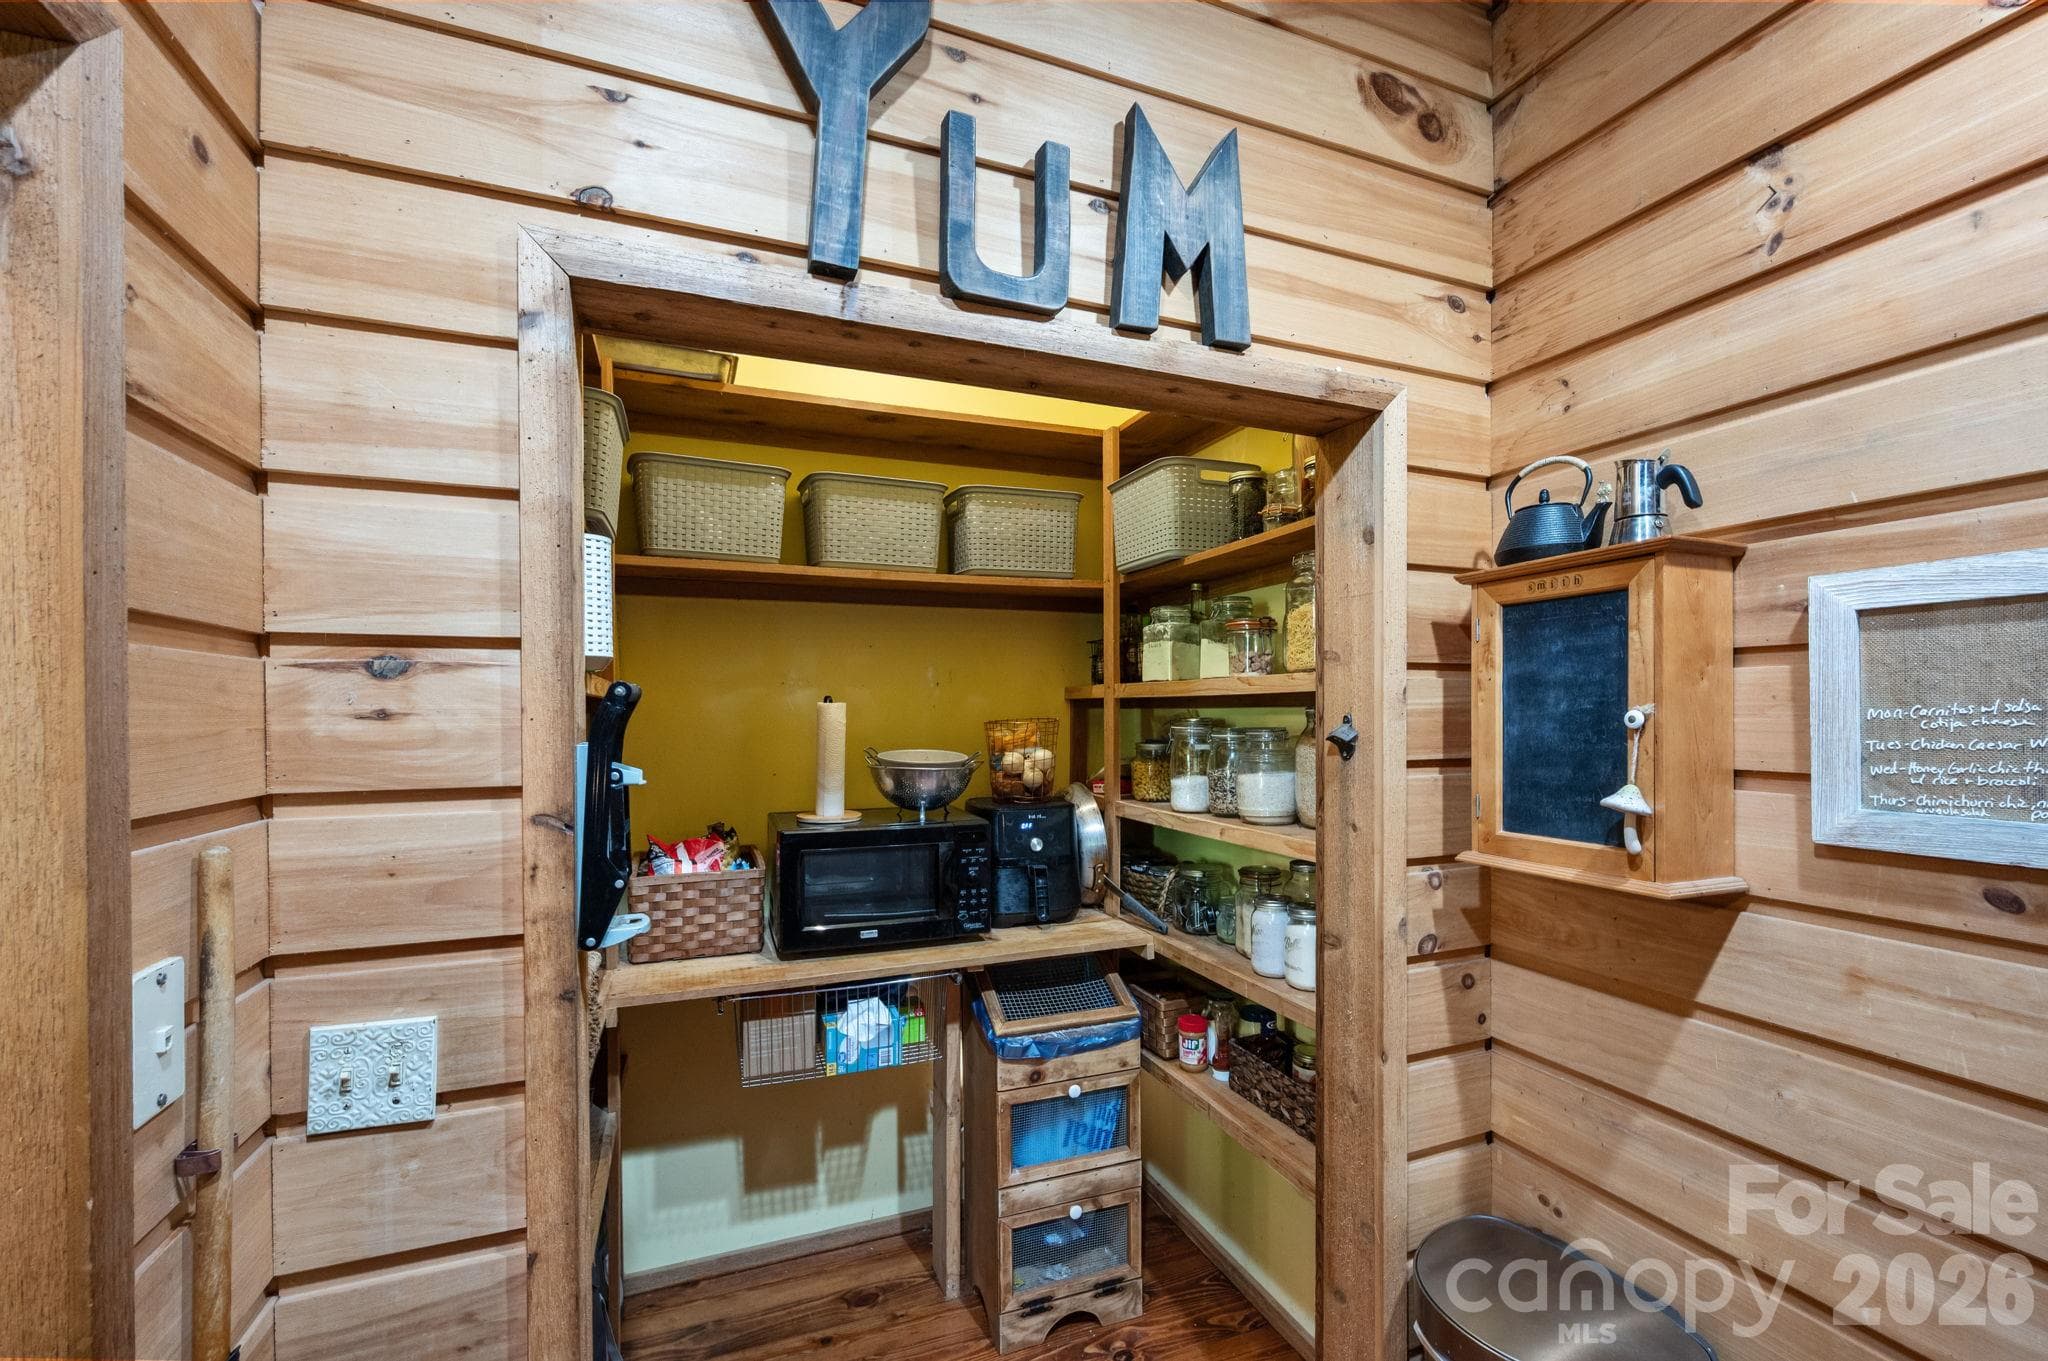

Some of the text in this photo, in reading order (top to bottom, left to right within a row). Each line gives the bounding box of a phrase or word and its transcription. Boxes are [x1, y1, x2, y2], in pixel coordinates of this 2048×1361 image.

[756, 0, 1252, 352] YUM
[1527, 575, 1582, 592] smith
[2004, 698, 2042, 713] salsa
[1920, 717, 2036, 732] cotija cheese
[1968, 739, 2023, 750] Caesar
[1932, 776, 1958, 785] rice
[1977, 776, 2038, 786] broccoli
